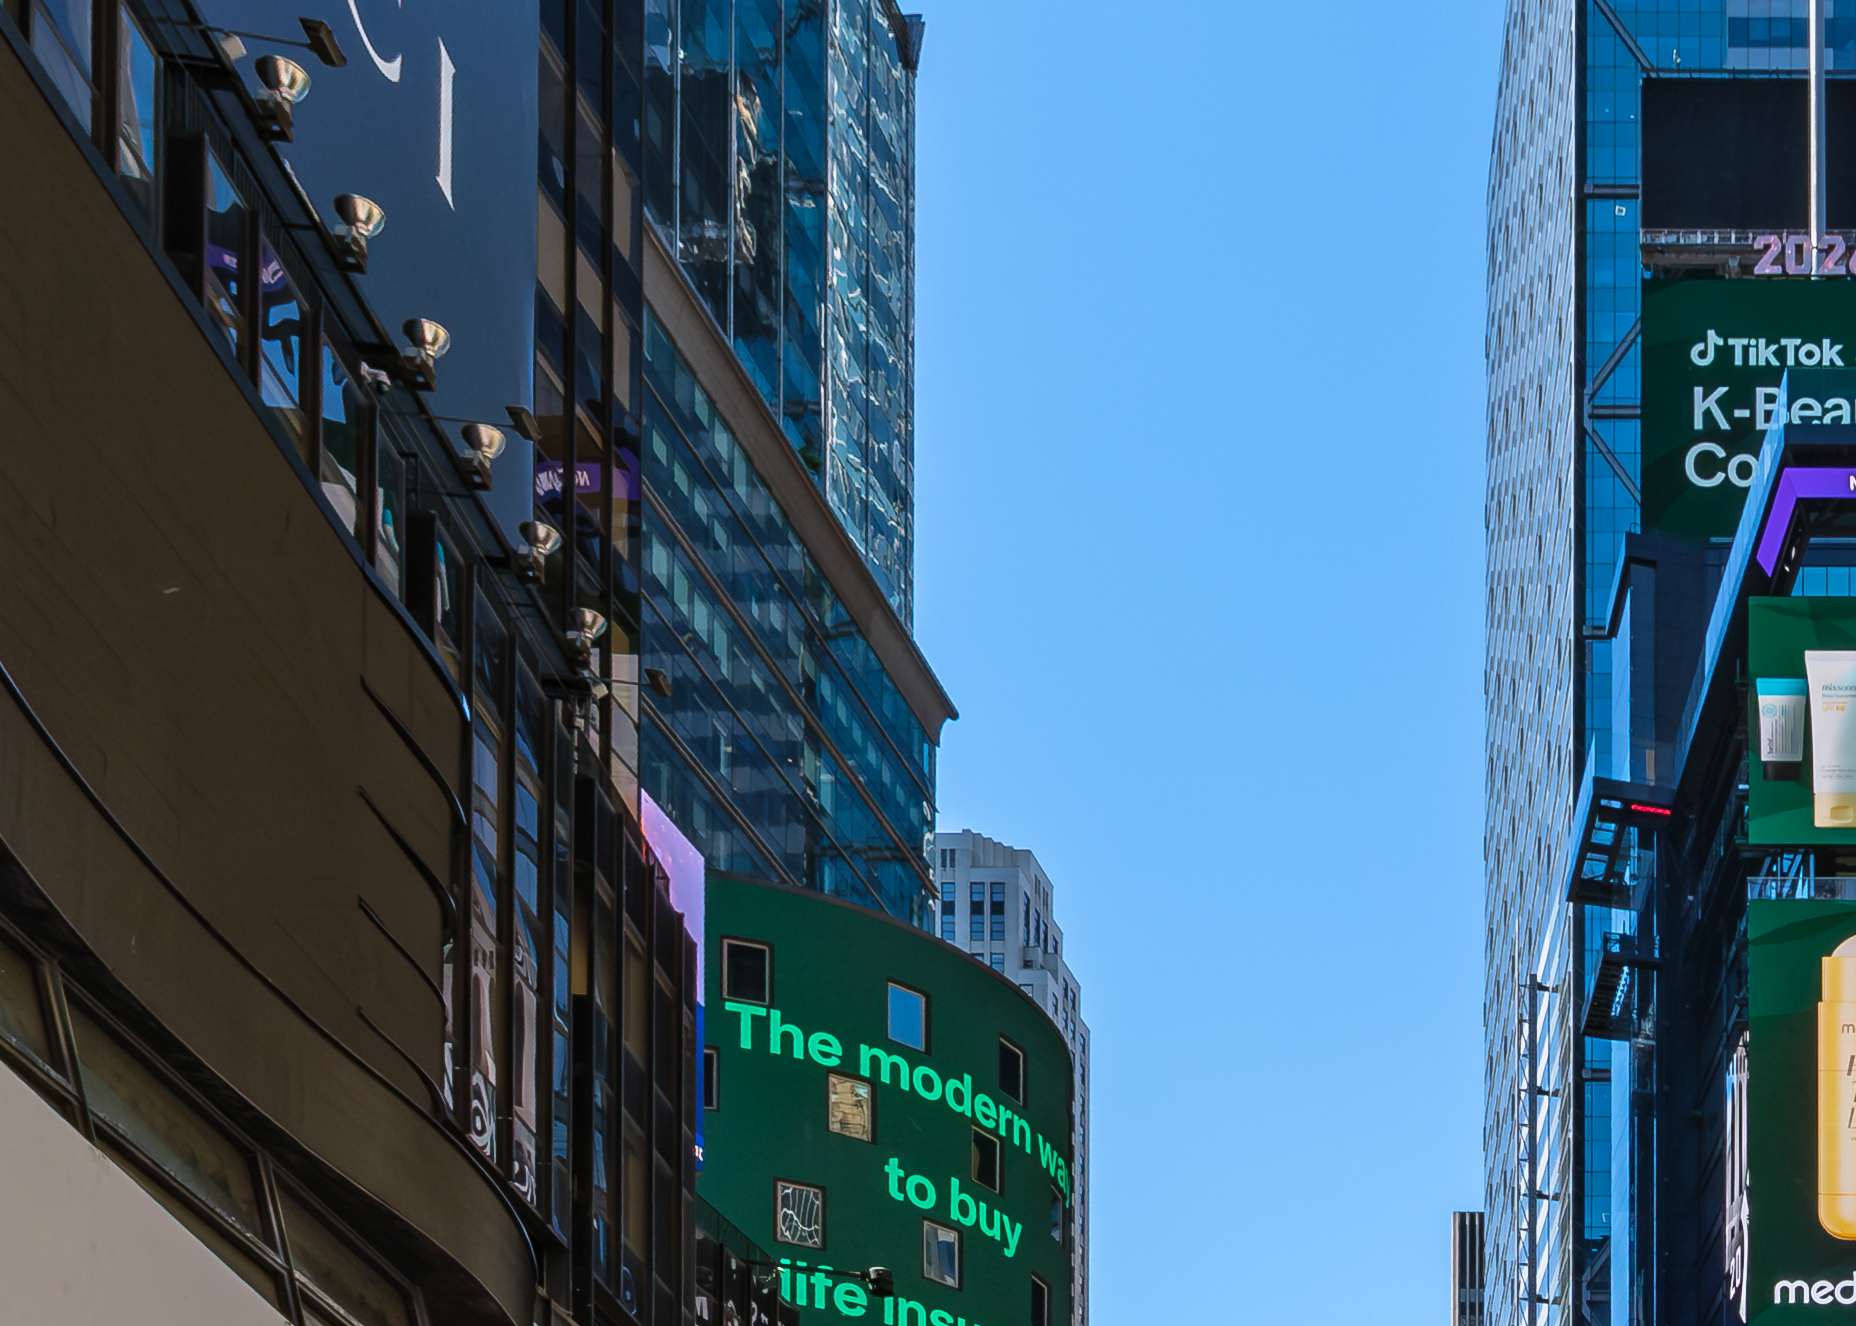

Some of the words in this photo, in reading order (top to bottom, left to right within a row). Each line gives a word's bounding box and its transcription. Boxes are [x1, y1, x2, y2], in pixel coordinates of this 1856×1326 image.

[1728, 337, 1844, 367] TikTok
[724, 1001, 842, 1068] The
[859, 1042, 1032, 1154] modern
[885, 1157, 937, 1210] to
[950, 1177, 1024, 1256] buy
[780, 1258, 867, 1318] life
